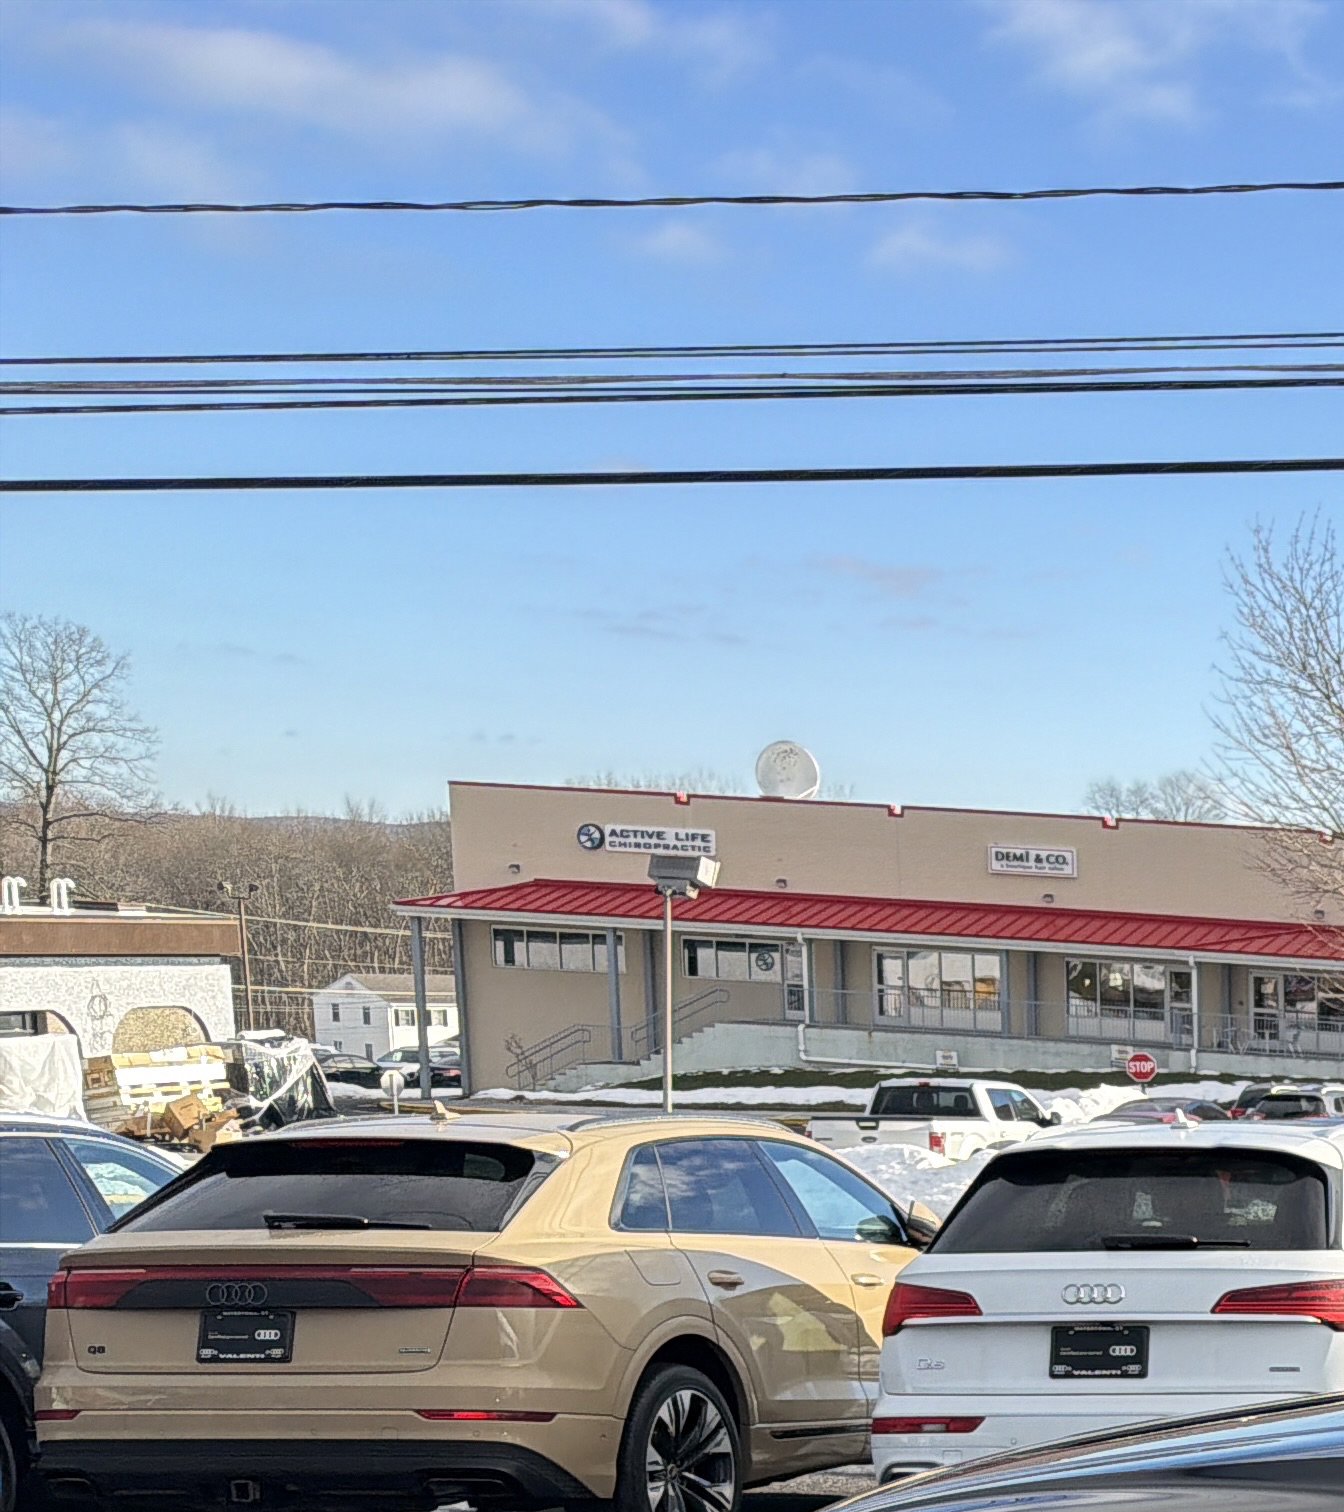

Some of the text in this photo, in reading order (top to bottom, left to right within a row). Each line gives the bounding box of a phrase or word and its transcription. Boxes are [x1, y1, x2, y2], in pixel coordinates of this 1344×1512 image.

[608, 829, 712, 843] ACTIVE LIFE
[608, 840, 712, 853] CHIROPRACTIC
[1033, 853, 1044, 864] &
[1128, 1060, 1155, 1073] STOP
